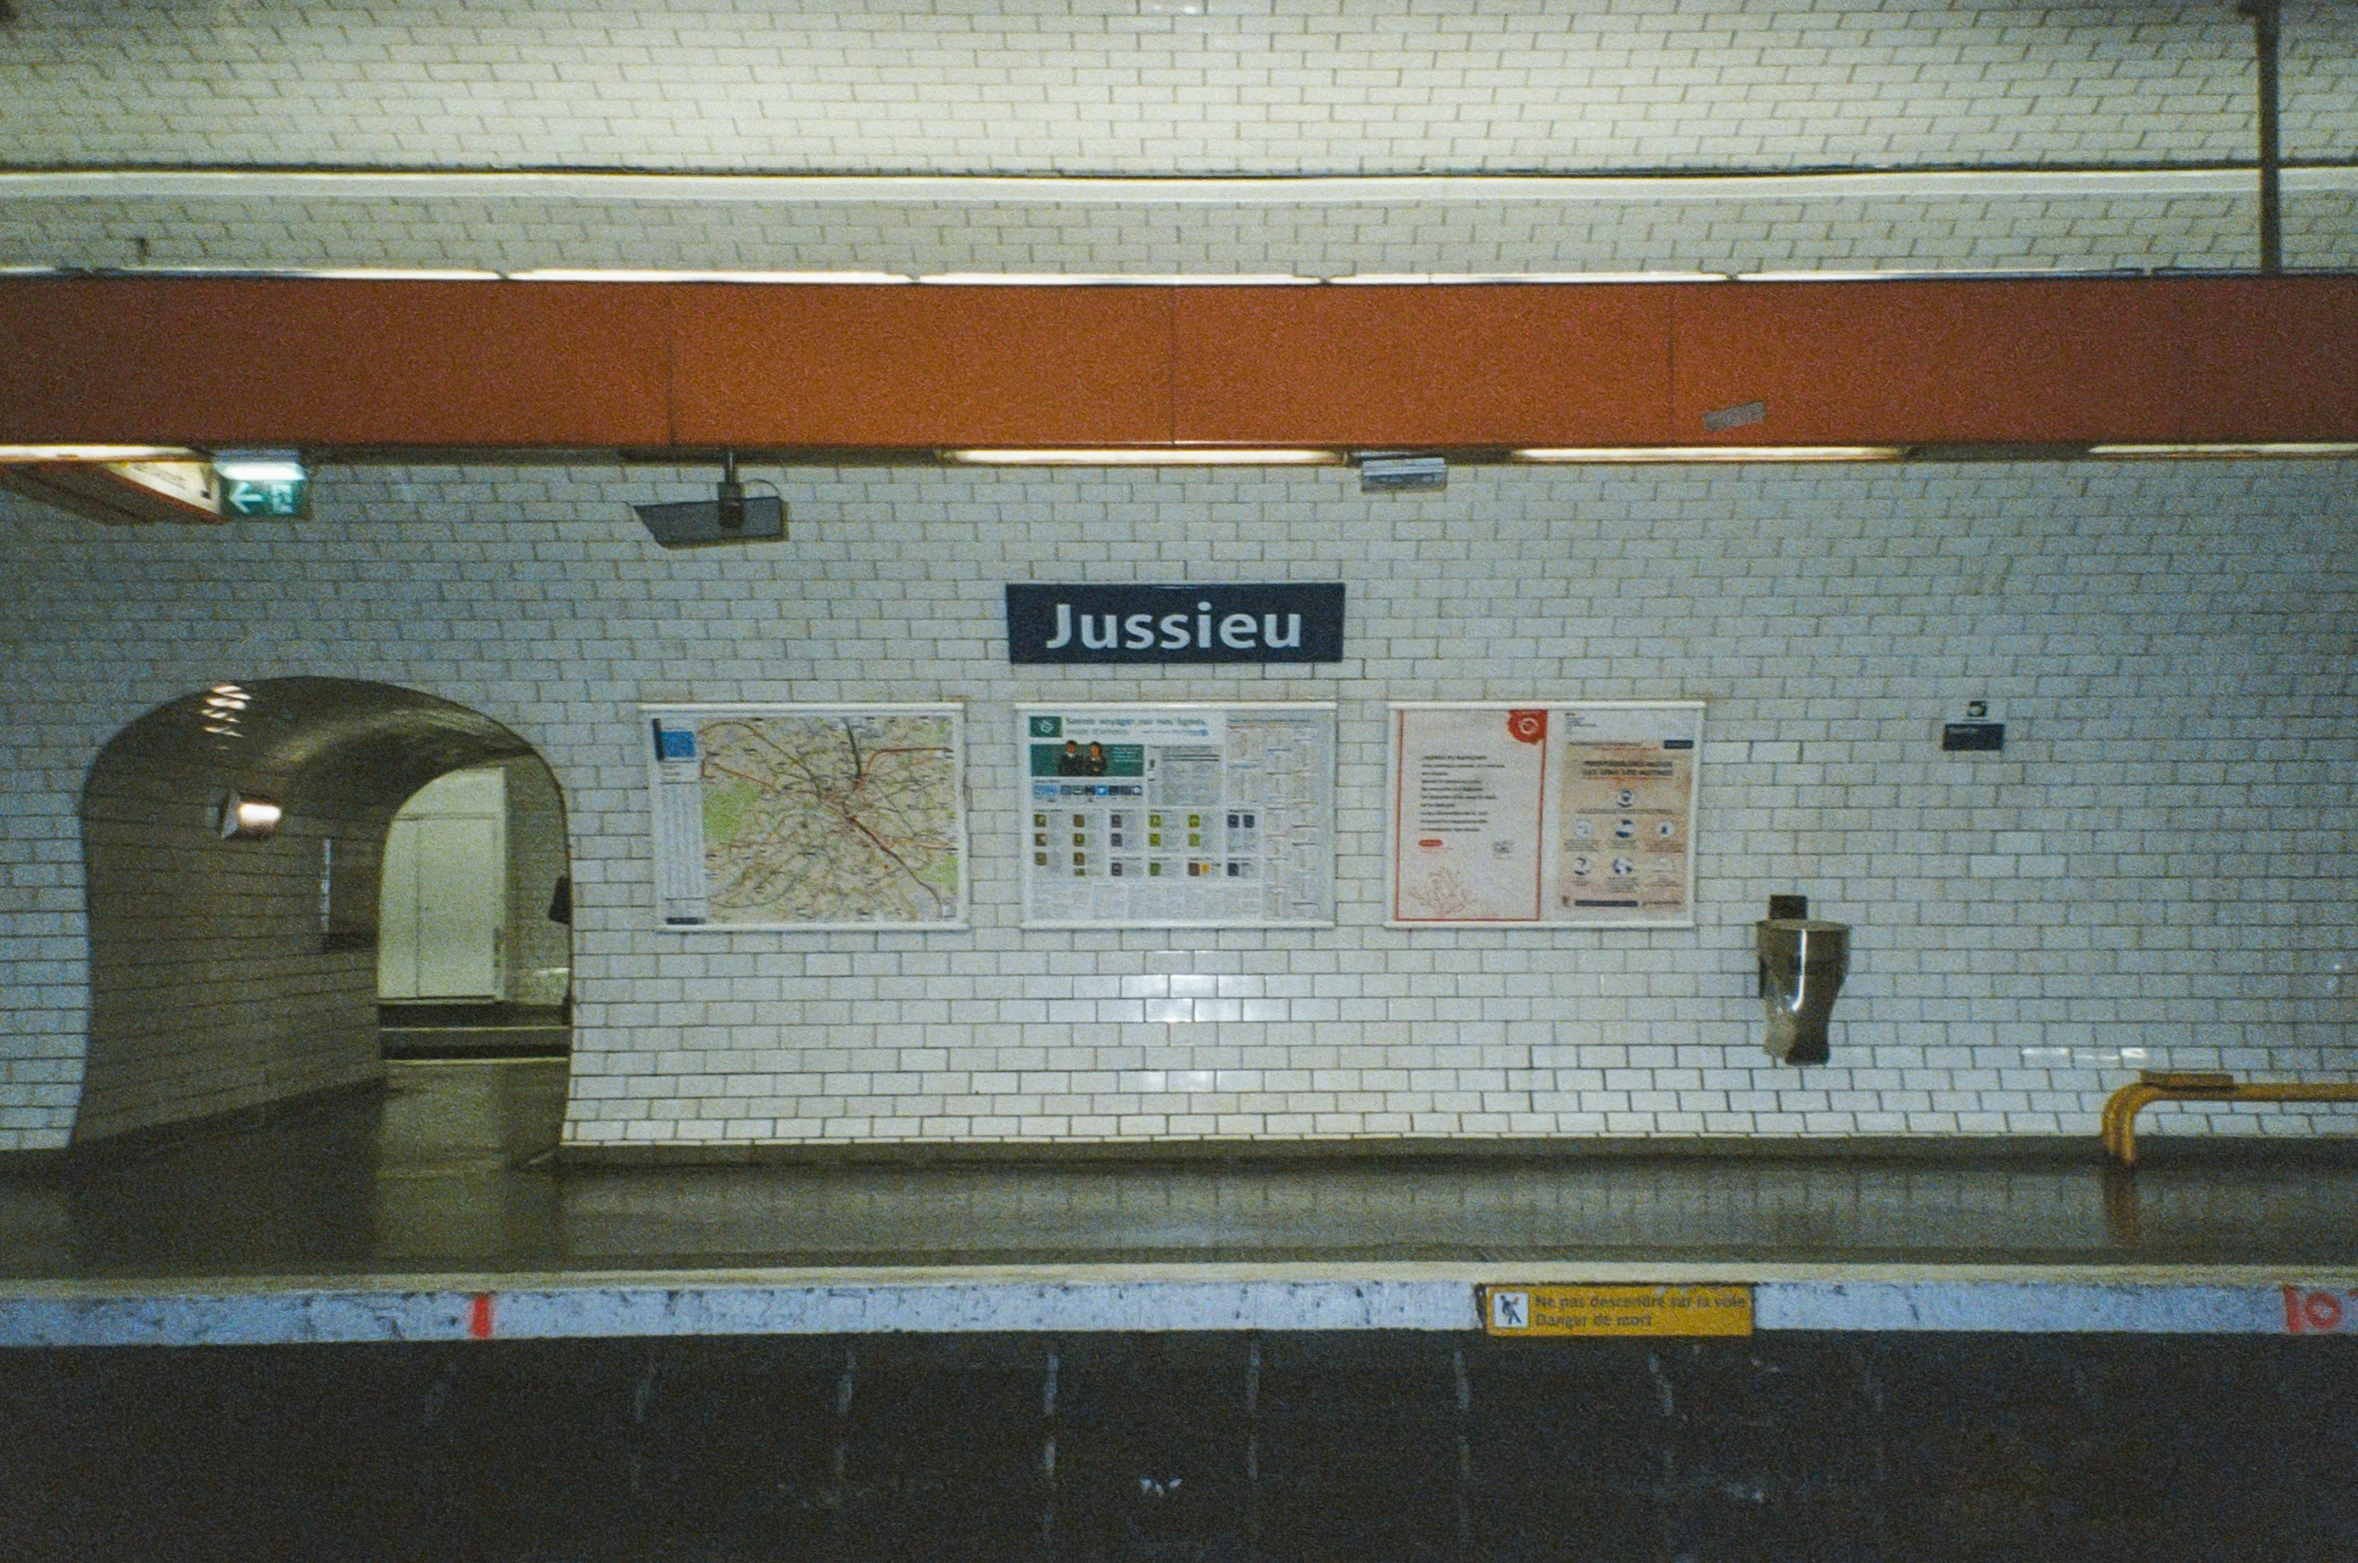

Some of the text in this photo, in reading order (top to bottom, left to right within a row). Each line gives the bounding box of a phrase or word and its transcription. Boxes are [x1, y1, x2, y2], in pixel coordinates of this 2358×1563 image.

[1045, 601, 1302, 650] Jussieu
[1535, 1294, 1745, 1311] Ne pas descendre sur la voie
[1535, 1312, 1653, 1329] Danger de mort
